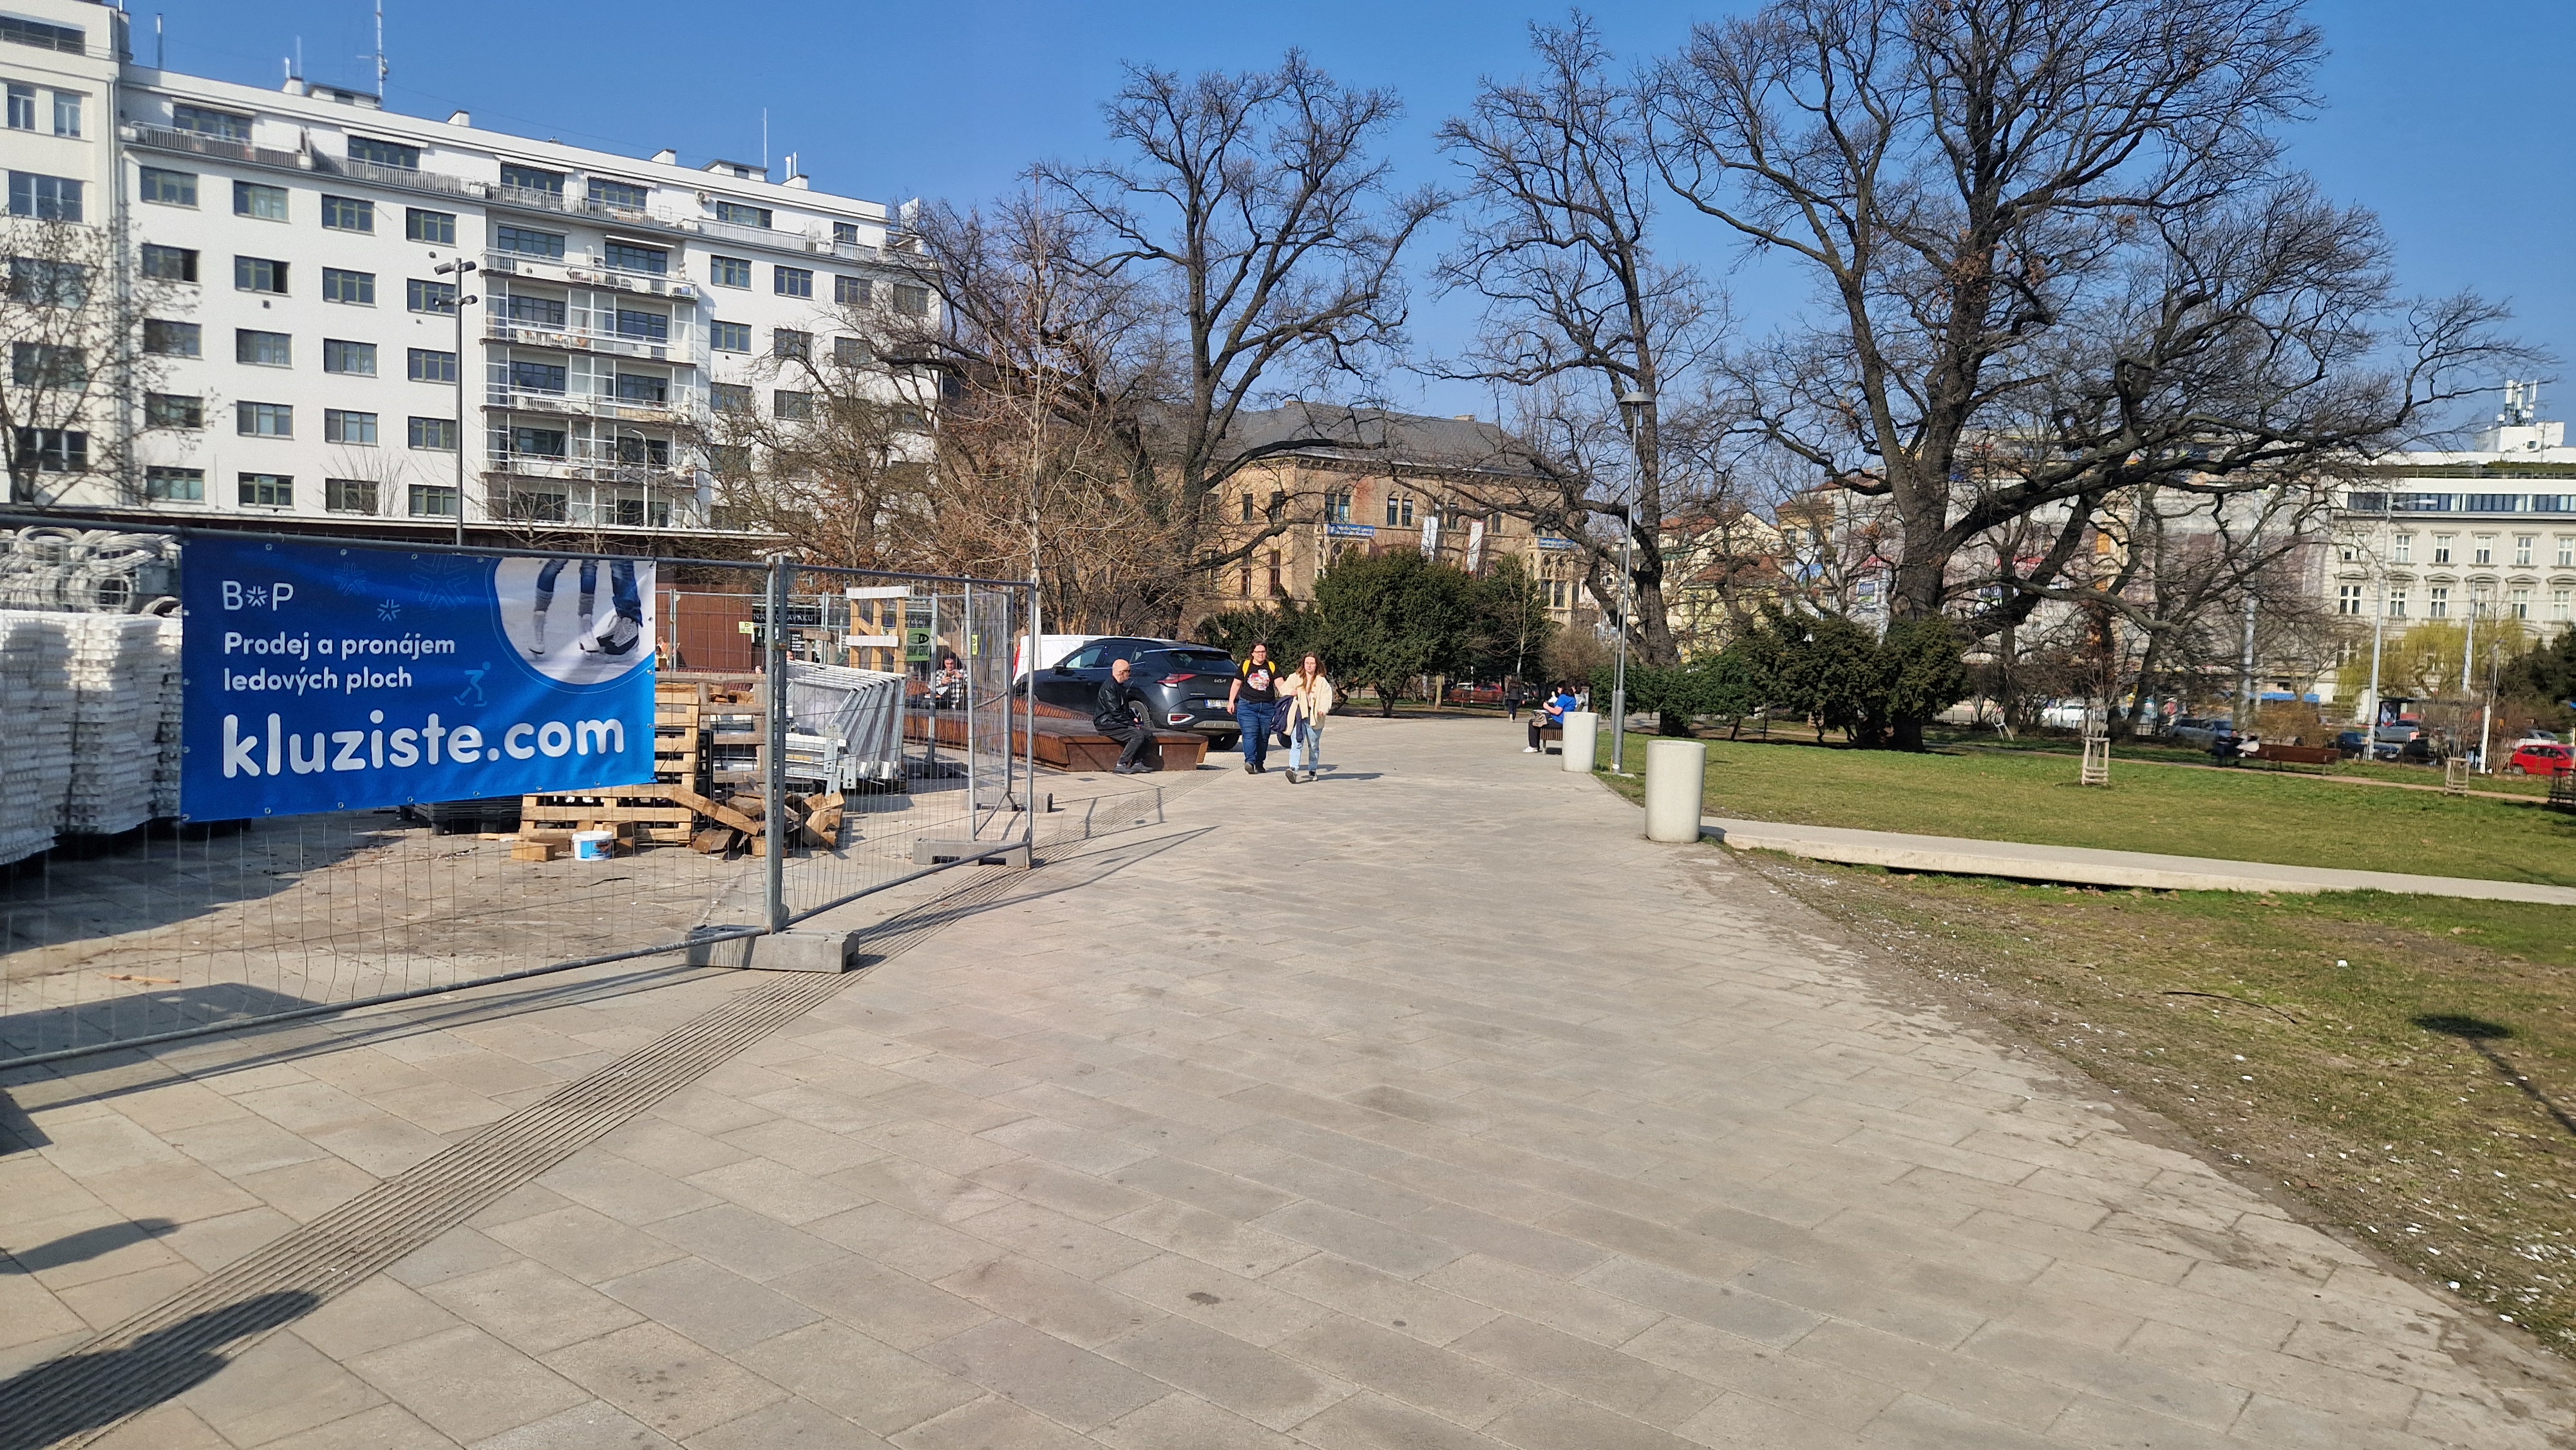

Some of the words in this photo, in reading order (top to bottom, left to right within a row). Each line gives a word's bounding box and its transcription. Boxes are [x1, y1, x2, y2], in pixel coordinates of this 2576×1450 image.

[223, 631, 310, 661] Prodej
[317, 639, 332, 654] a
[341, 632, 455, 661] pronájem
[223, 666, 338, 697] ledových
[346, 666, 412, 695] ploch
[222, 710, 625, 778] kluziste.com
